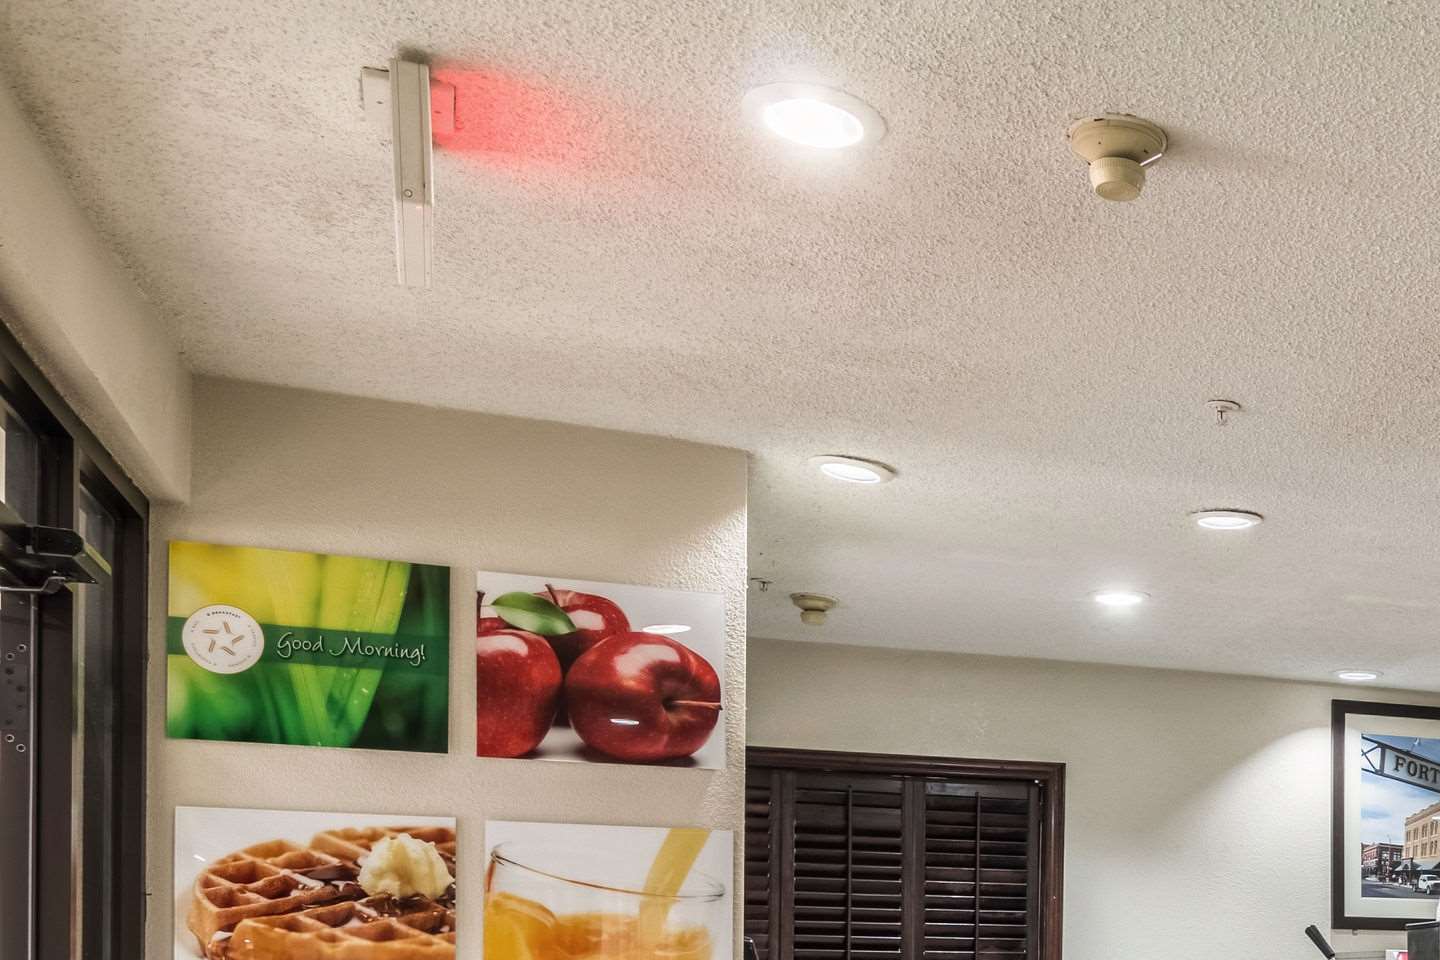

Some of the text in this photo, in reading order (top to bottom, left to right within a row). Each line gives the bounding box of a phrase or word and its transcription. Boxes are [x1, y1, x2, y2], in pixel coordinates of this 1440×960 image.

[277, 632, 324, 658] Good
[329, 636, 426, 667] Morning!
[1394, 755, 1440, 784] FORT
